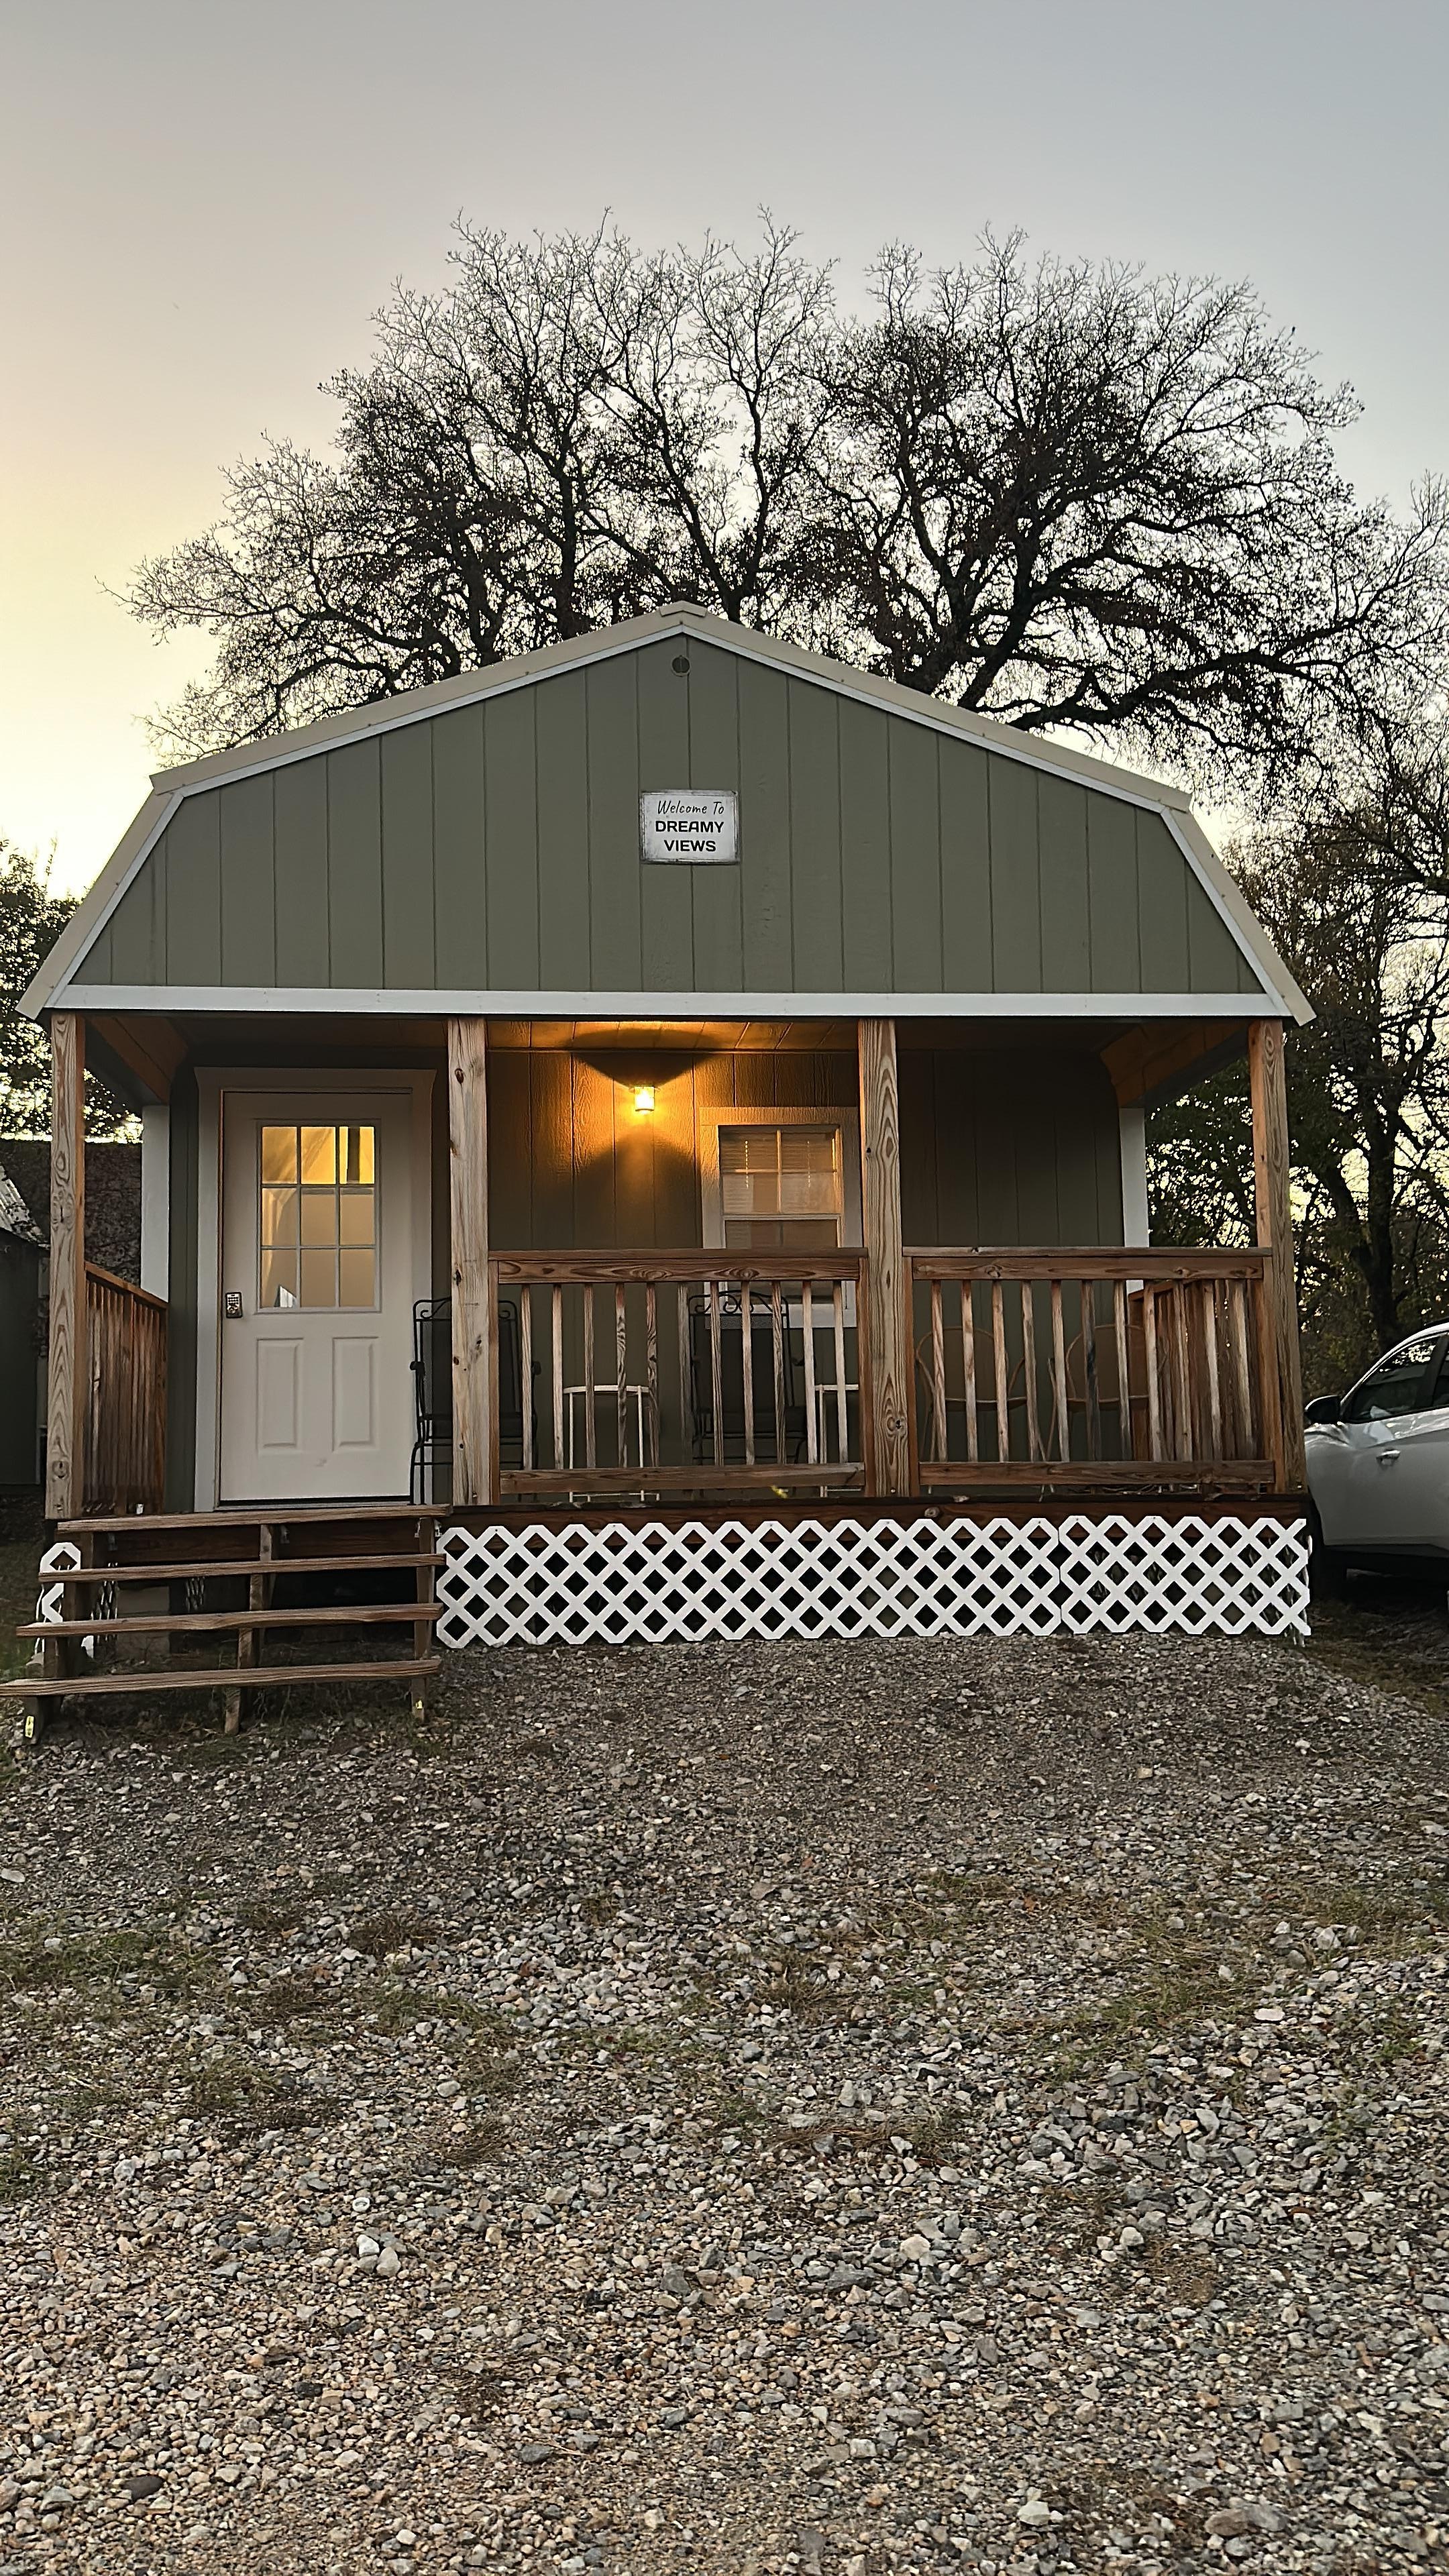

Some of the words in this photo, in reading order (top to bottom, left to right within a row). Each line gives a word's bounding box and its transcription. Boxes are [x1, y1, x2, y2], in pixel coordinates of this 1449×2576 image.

[657, 800, 707, 814] Welcome
[713, 802, 724, 815] To
[655, 821, 724, 833] DREAMY
[664, 840, 716, 852] VIEWS
